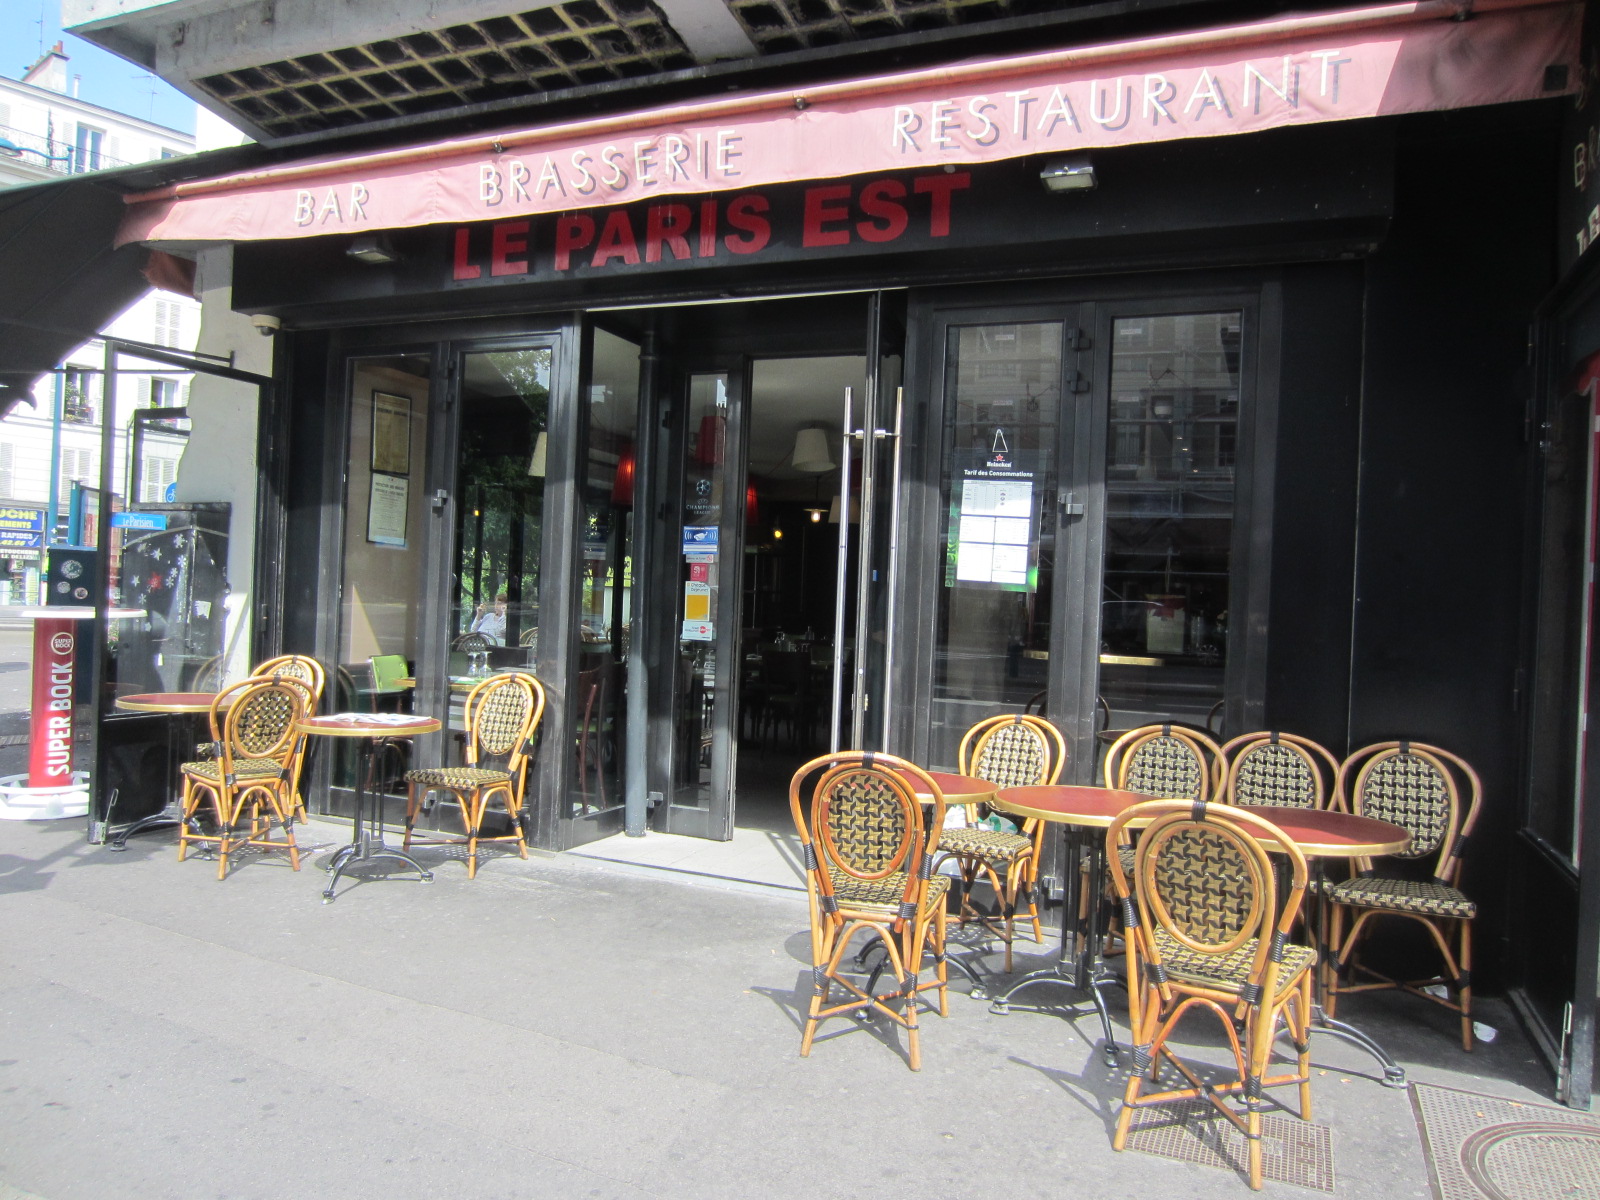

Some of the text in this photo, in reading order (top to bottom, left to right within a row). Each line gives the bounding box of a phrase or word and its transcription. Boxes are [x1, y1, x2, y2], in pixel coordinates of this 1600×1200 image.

[294, 51, 1347, 224] BAR BRASSERIE RESTAURANT
[453, 172, 970, 281] LE PARIS EST
[989, 470, 1034, 478] Consommations
[48, 661, 73, 777] SUPER BOCK
